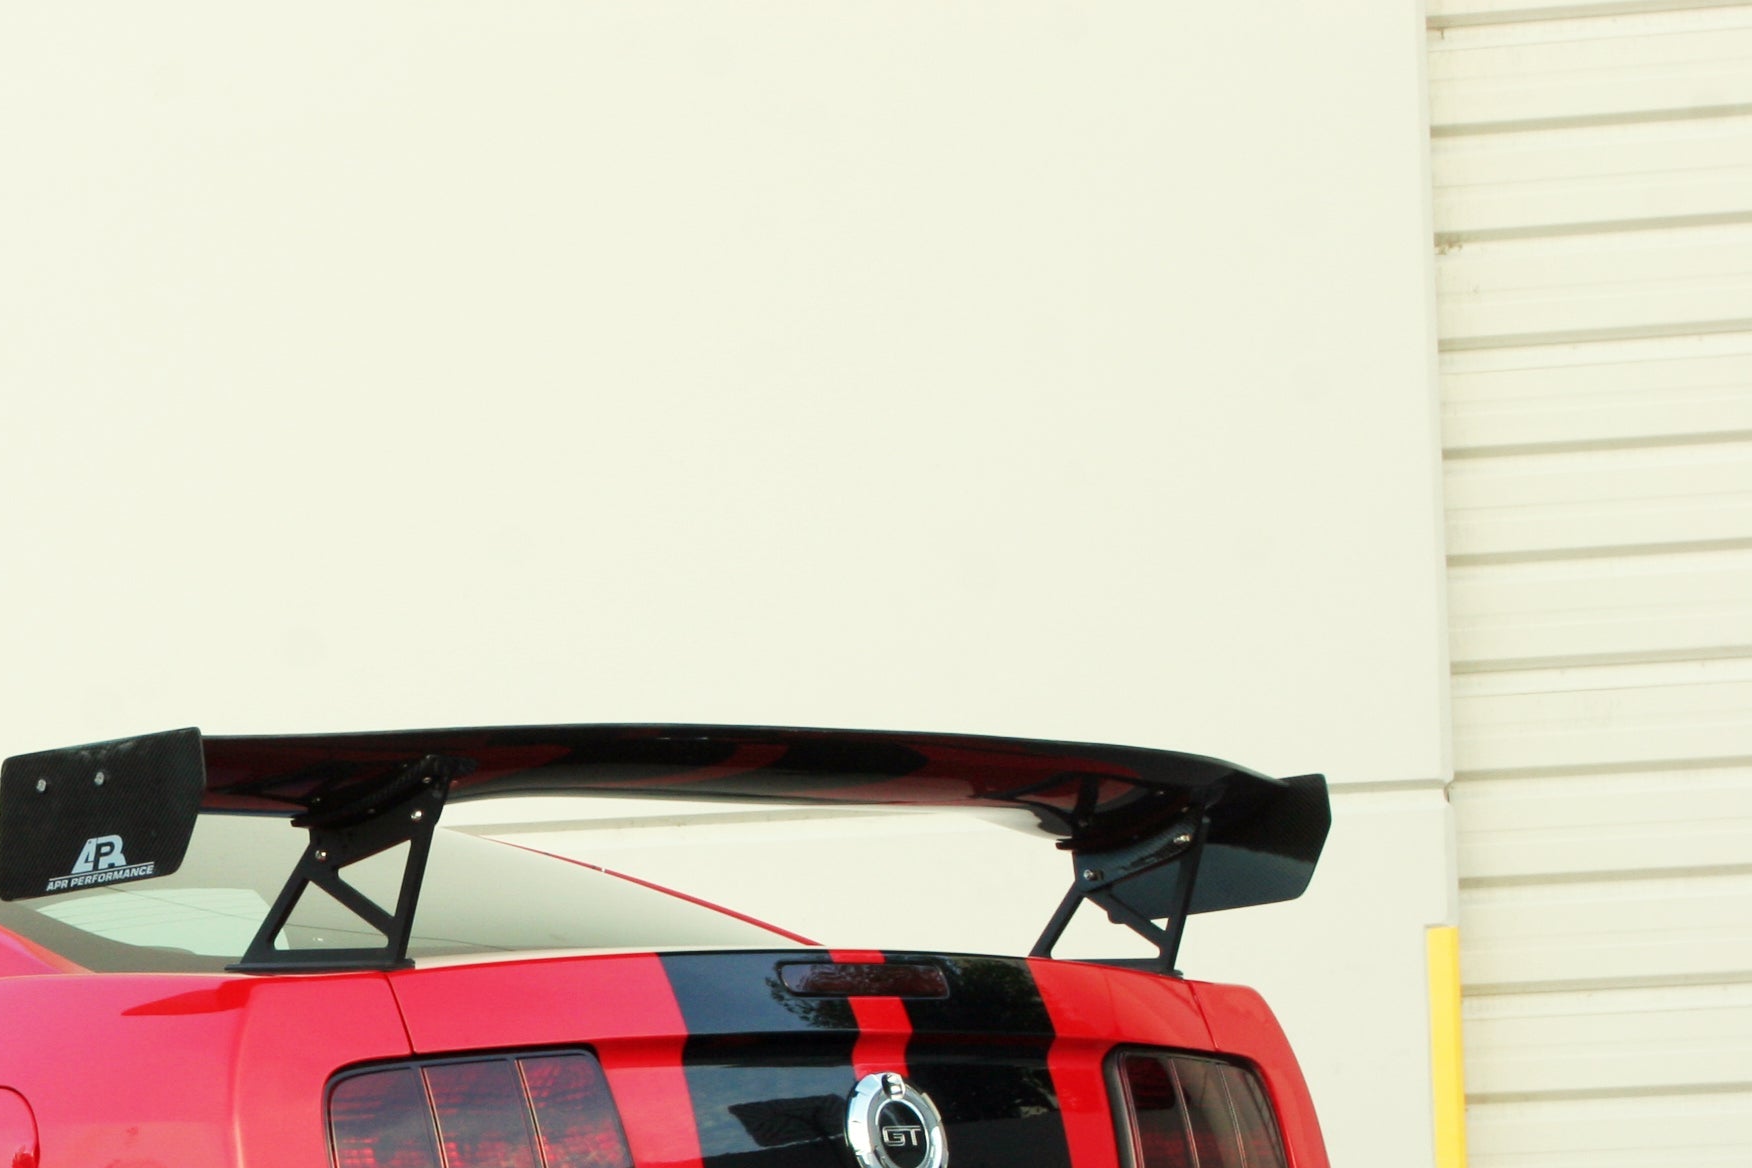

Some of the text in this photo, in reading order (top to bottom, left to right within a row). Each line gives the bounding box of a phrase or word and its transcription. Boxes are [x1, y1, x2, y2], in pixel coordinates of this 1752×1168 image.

[71, 835, 127, 875] APR
[46, 865, 154, 892] APR PERFORMANCE
[882, 1125, 921, 1146] GT
